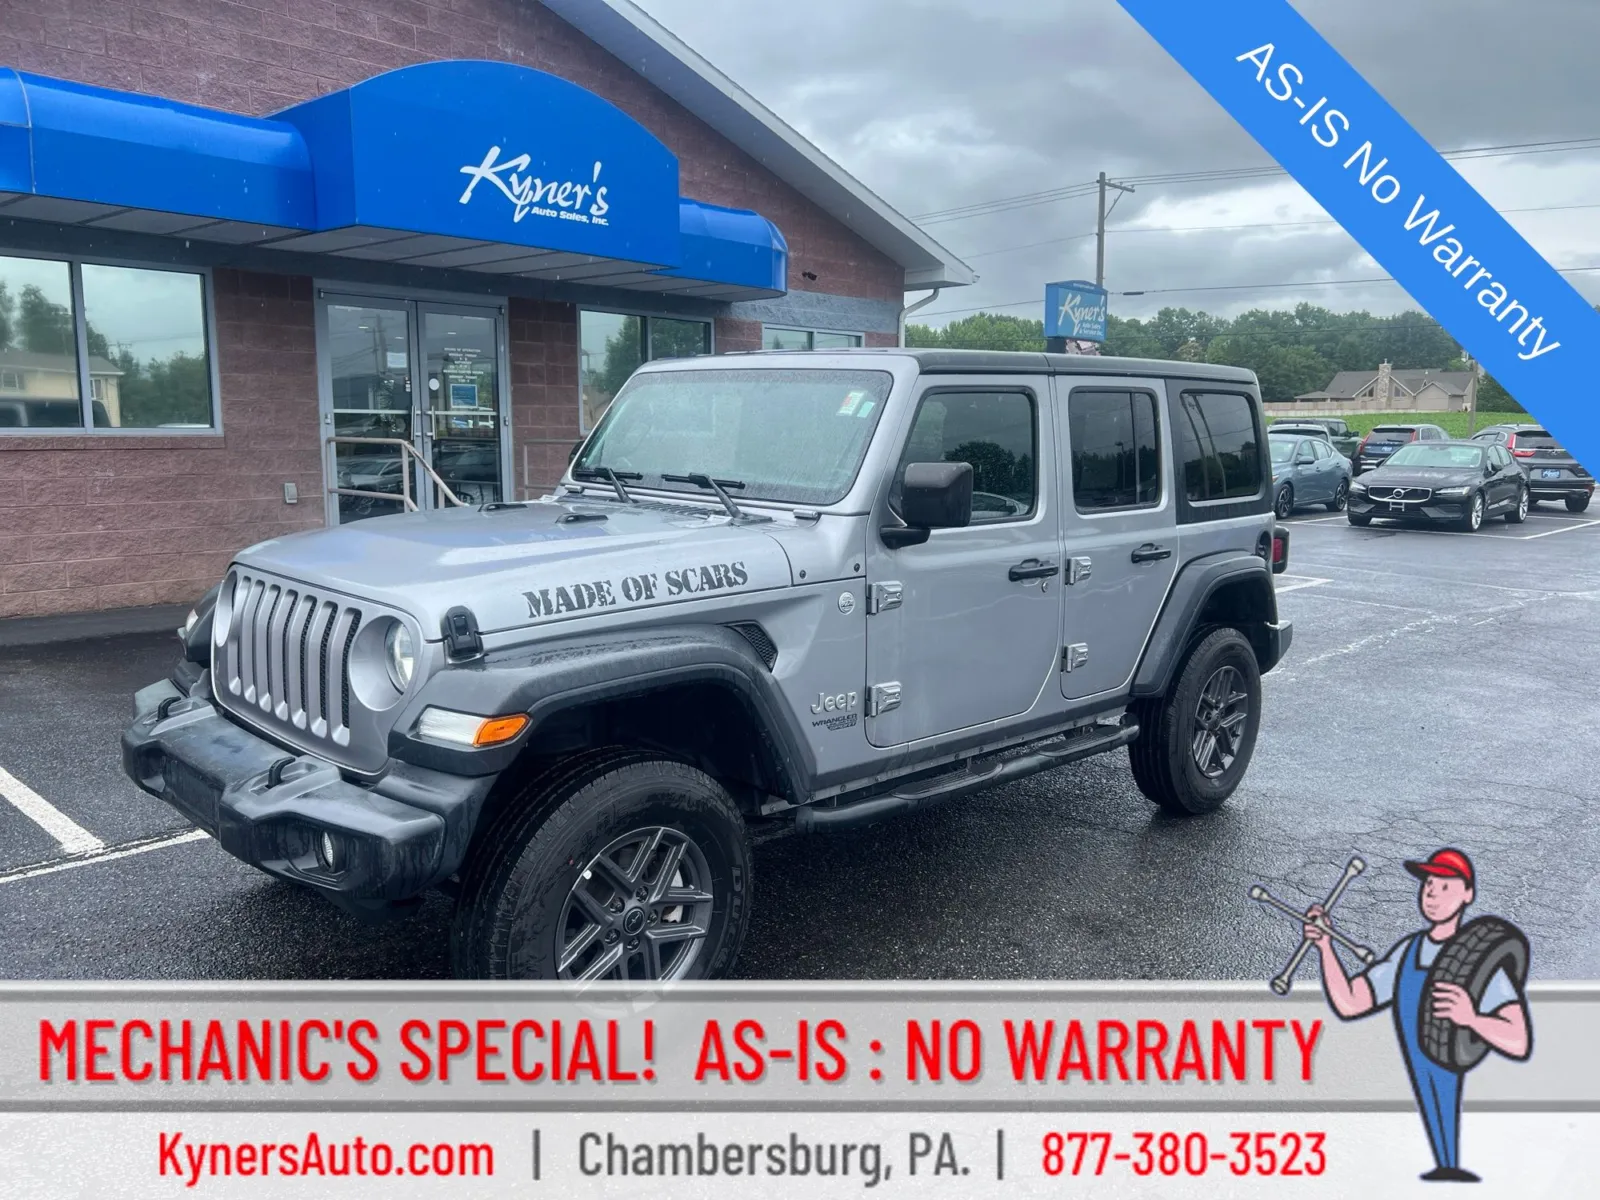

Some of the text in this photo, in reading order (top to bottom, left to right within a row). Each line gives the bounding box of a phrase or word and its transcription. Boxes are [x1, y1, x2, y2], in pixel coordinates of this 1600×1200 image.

[458, 145, 609, 223] Kyner's
[531, 206, 609, 226] Auto Sales, Inc.
[1058, 292, 1105, 336] Kyner's
[522, 561, 749, 619] MADE OF SCARS
[810, 691, 858, 715] Jeep
[811, 713, 858, 727] WRANGLER
